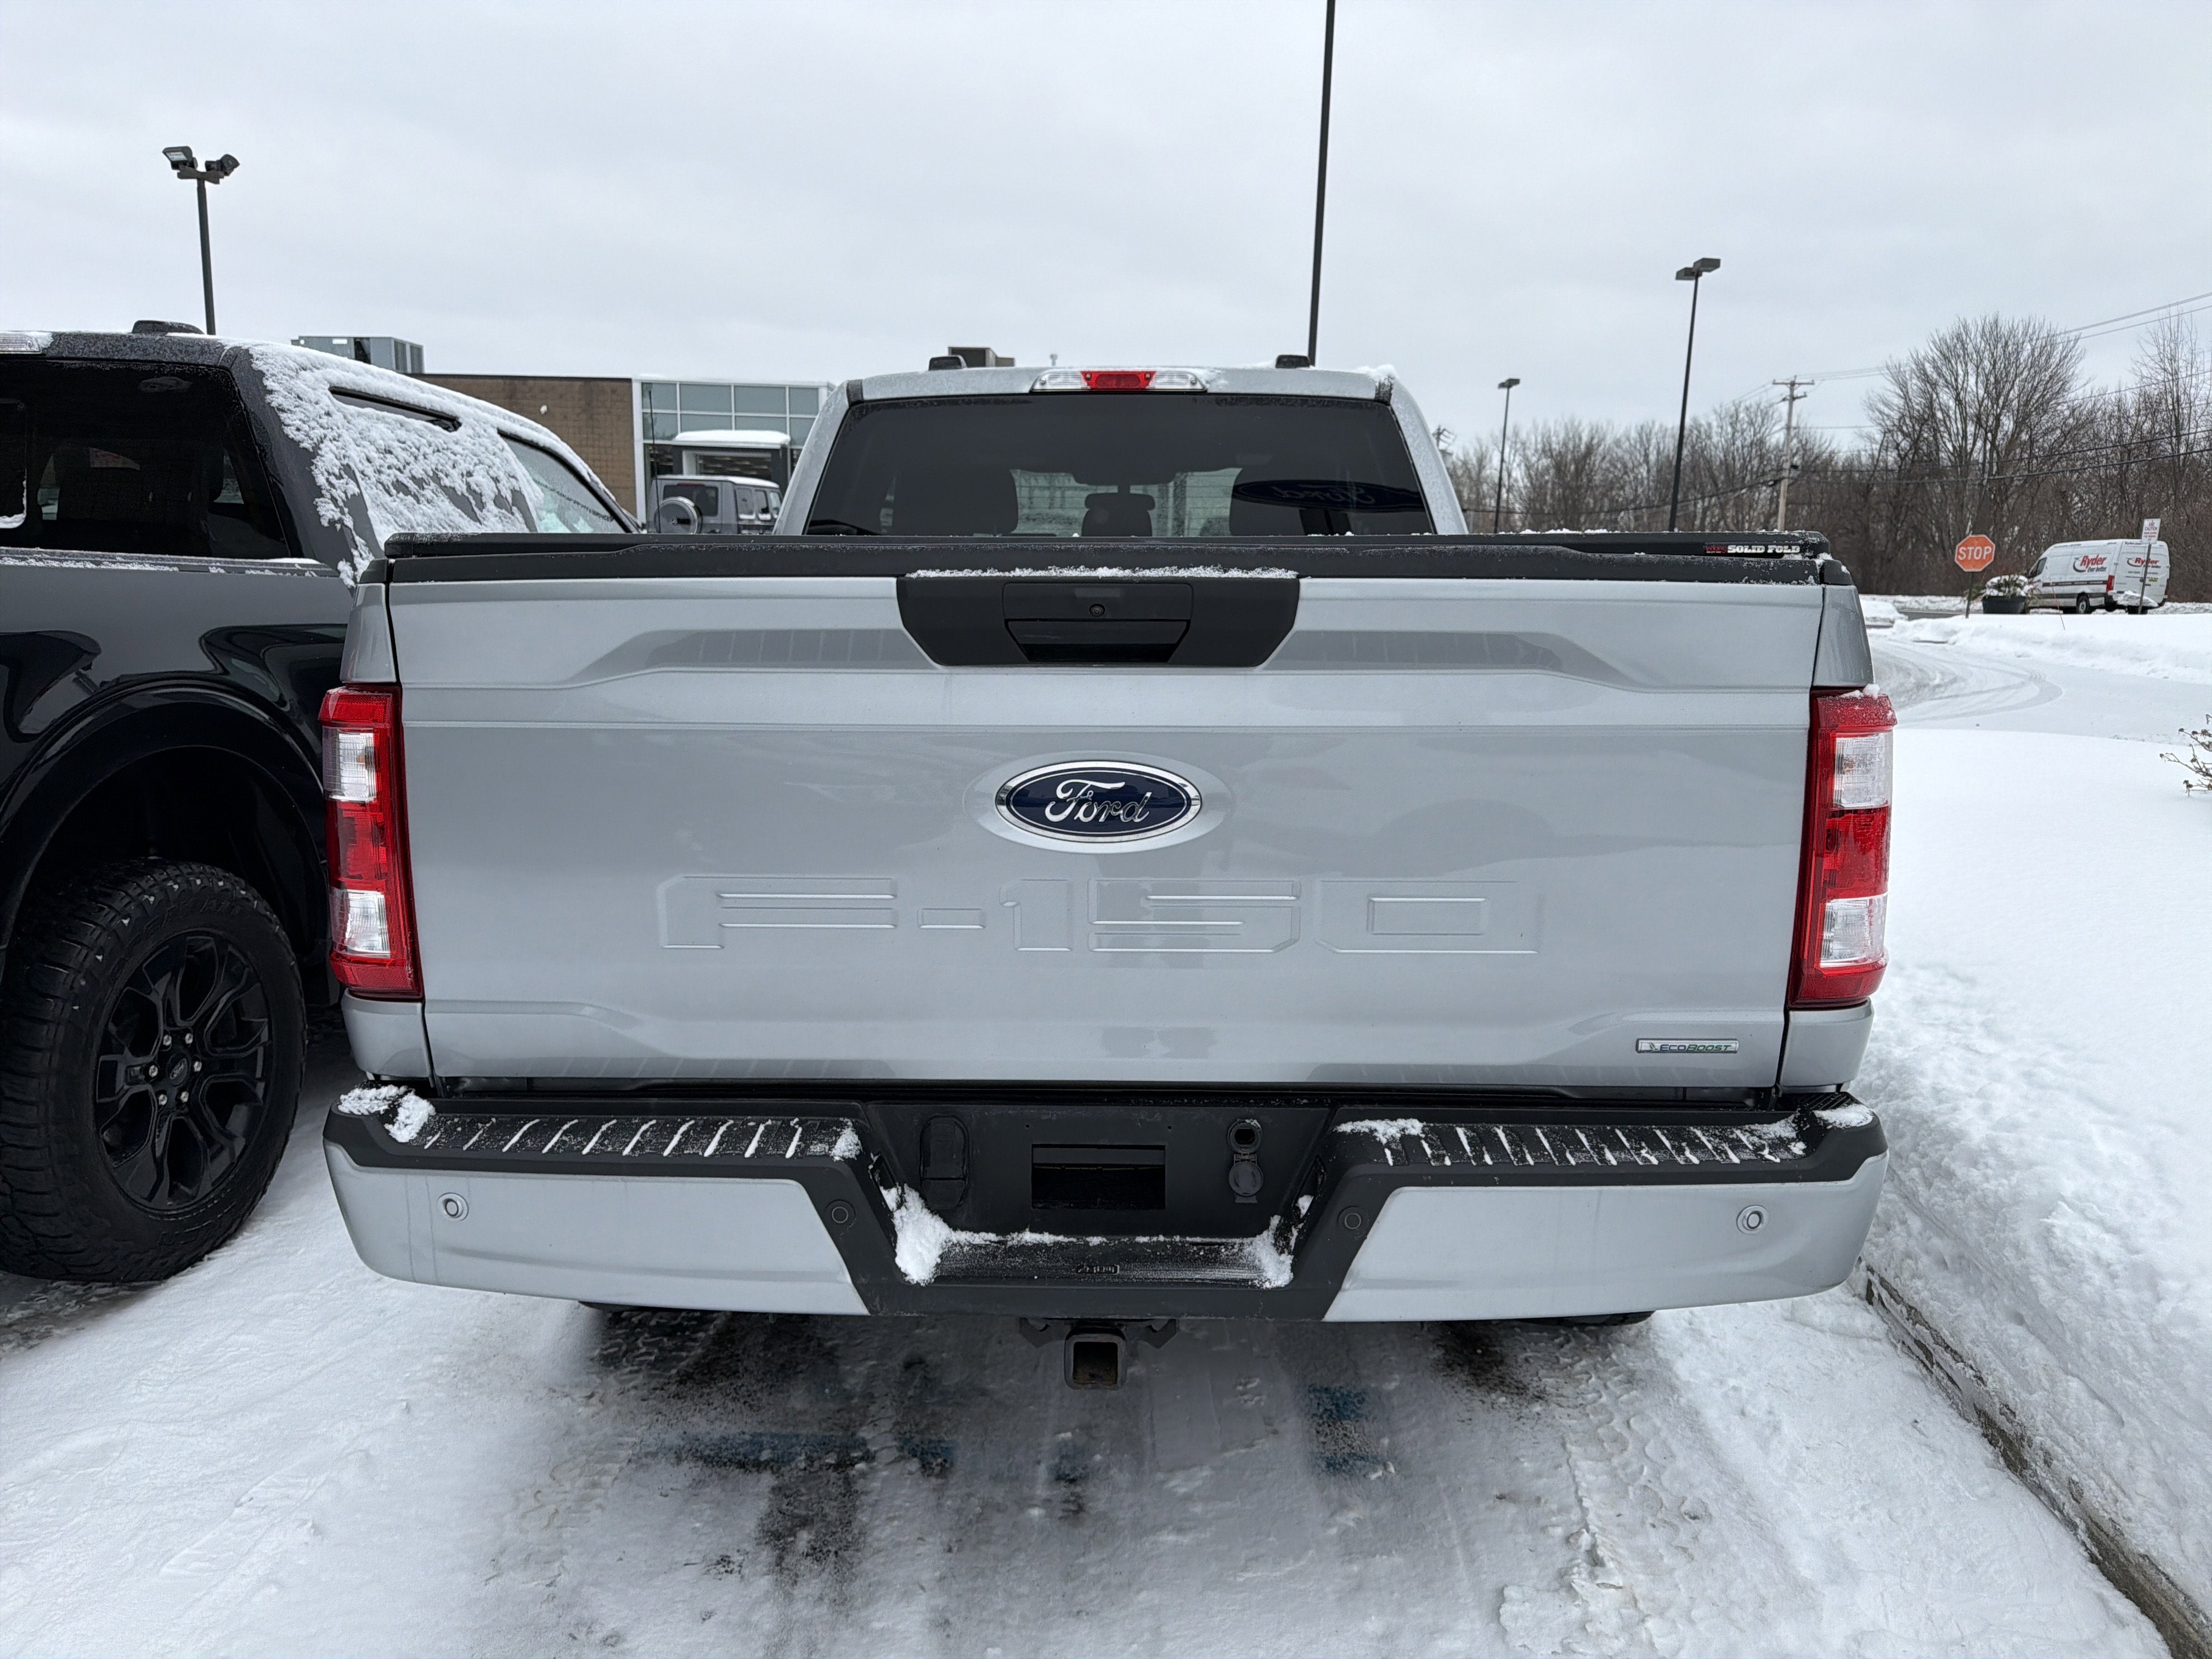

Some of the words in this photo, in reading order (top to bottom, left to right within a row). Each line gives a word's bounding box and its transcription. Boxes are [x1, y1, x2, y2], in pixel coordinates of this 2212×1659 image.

[1728, 545, 1765, 553] SOLID
[1767, 545, 1800, 553] FOLD
[1958, 546, 1992, 560] STOP
[2080, 554, 2107, 569] Ryder
[1045, 779, 1152, 823] Ford
[657, 876, 1544, 954] F-150
